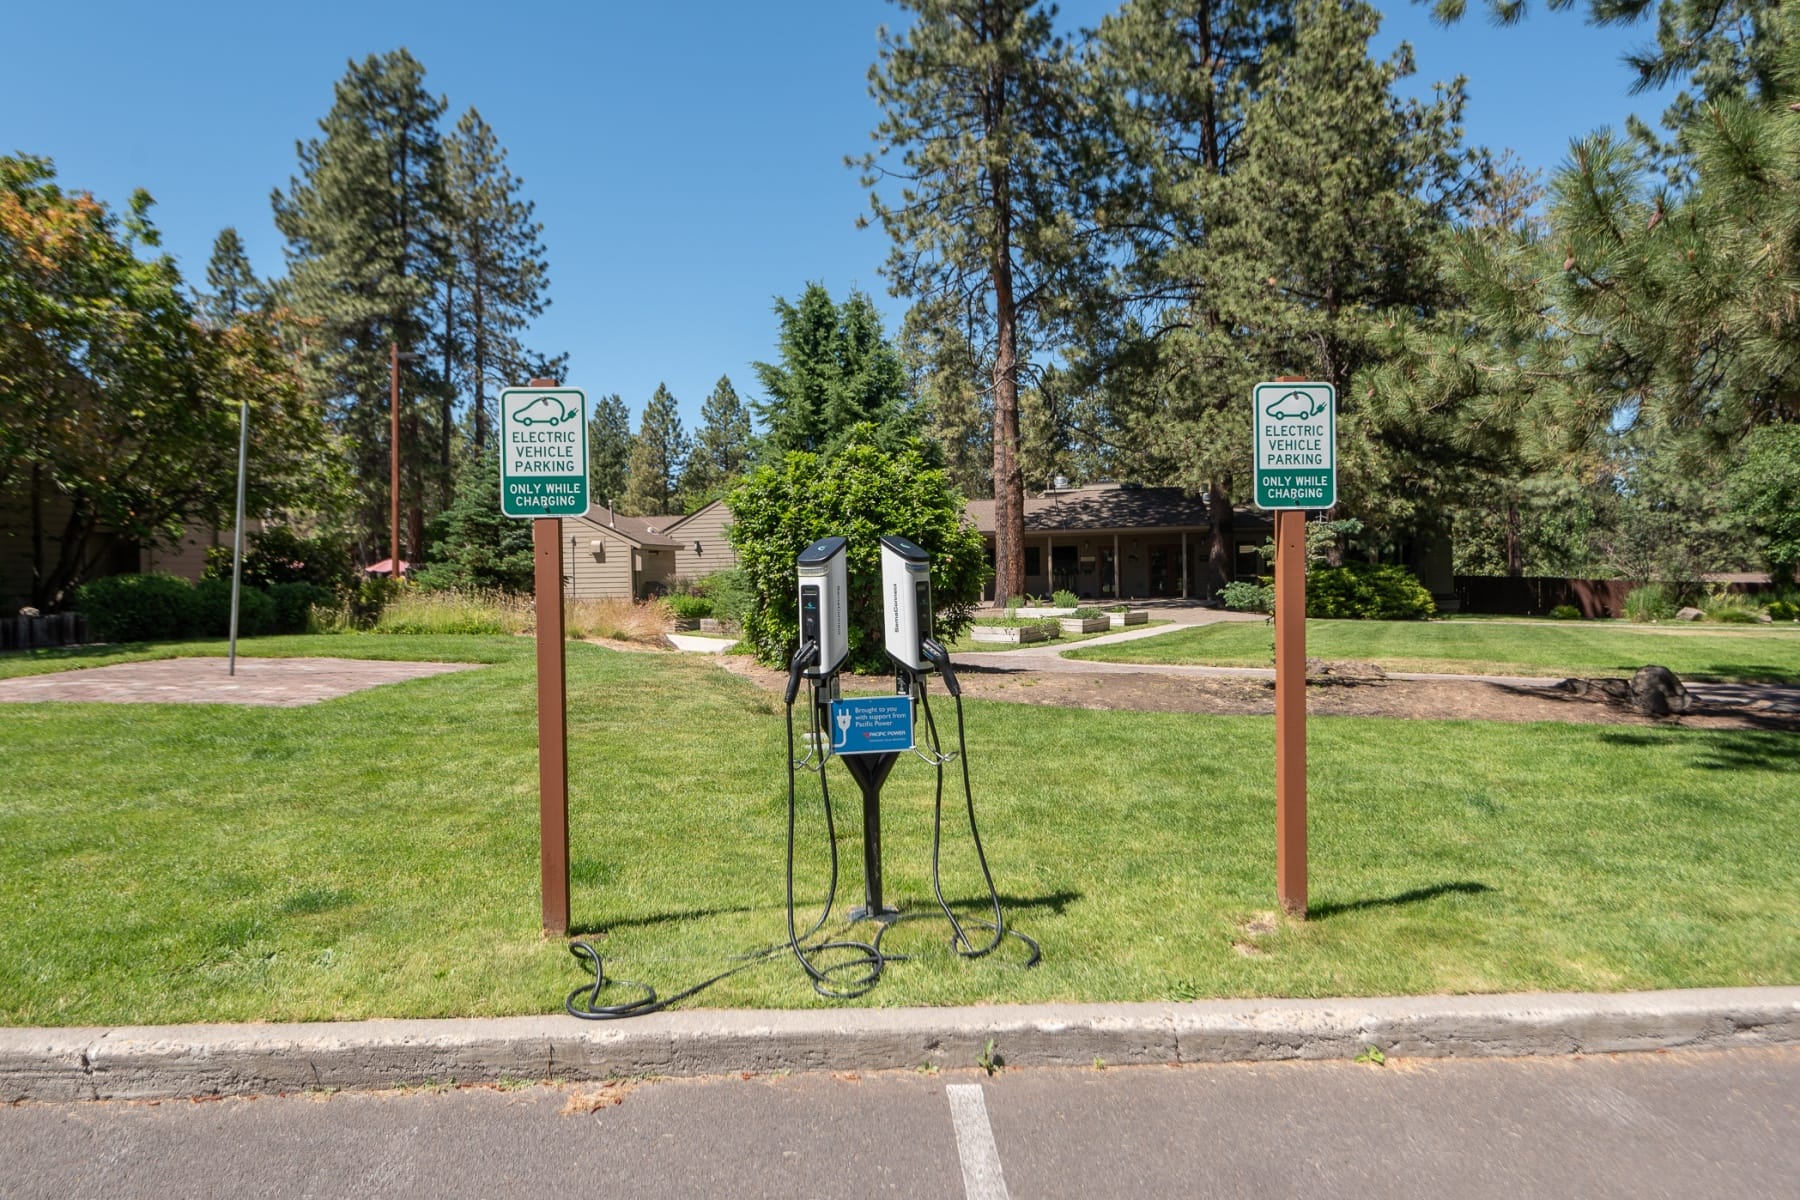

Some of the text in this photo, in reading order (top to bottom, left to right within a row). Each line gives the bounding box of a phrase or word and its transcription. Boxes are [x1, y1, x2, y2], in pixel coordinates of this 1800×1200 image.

[512, 431, 576, 443] ELECTRIC
[1265, 425, 1324, 437] ELECTRIC
[1268, 439, 1322, 451] VEHICLE
[515, 446, 574, 458] VEHICLE
[1267, 453, 1322, 465] PARKING
[515, 460, 575, 472] PARKING
[1262, 476, 1328, 486] ONLY WHILE
[509, 483, 582, 494] ONLY WHILE
[1267, 488, 1323, 499] CHARGING
[515, 495, 576, 507] CHARGING
[869, 713, 892, 721] support
